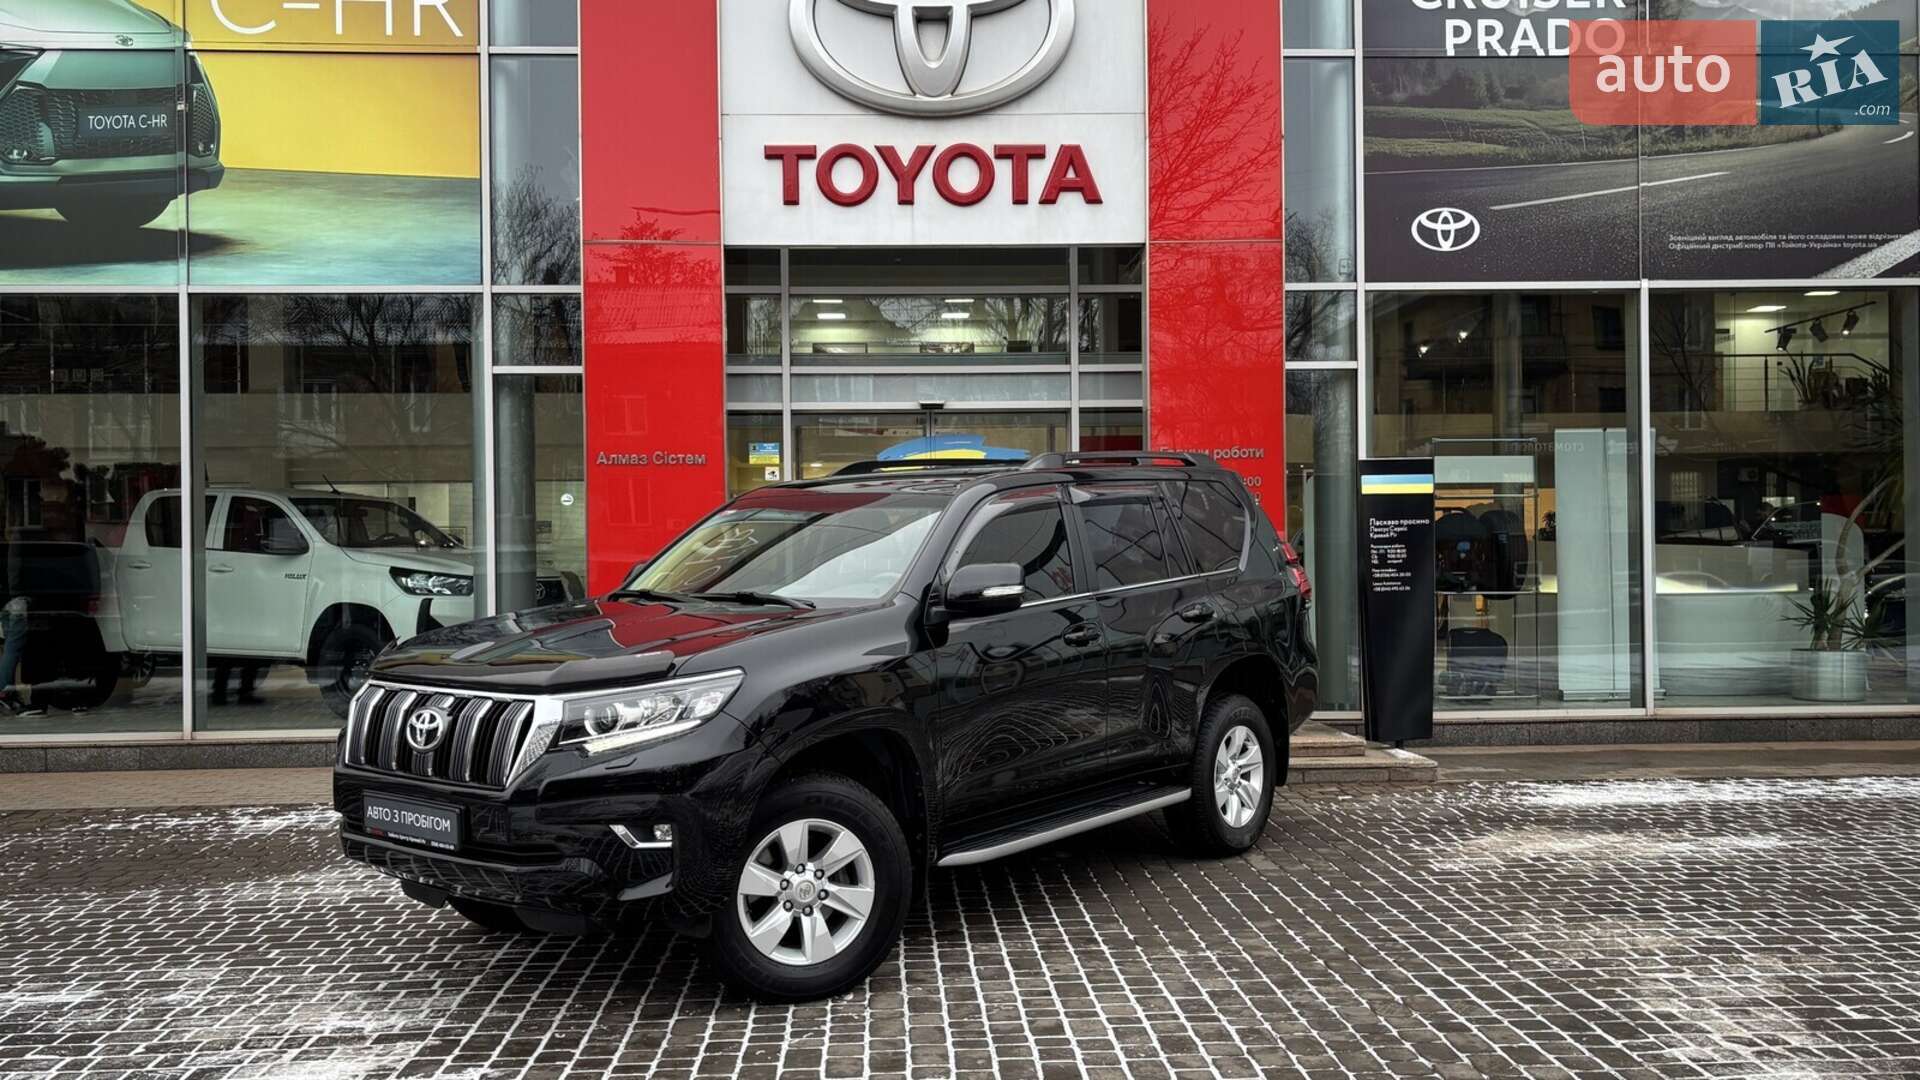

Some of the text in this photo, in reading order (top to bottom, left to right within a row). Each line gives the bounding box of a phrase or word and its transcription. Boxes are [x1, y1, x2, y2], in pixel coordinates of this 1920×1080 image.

[1445, 18, 1627, 56] PRADO
[88, 114, 168, 130] TOYOTA C-HR
[764, 143, 1103, 207] TOYOTA
[596, 451, 706, 465] Алмаз Сістем
[1213, 445, 1264, 460] роботи
[367, 806, 451, 832] АВТО З ПРОБІГОМ
